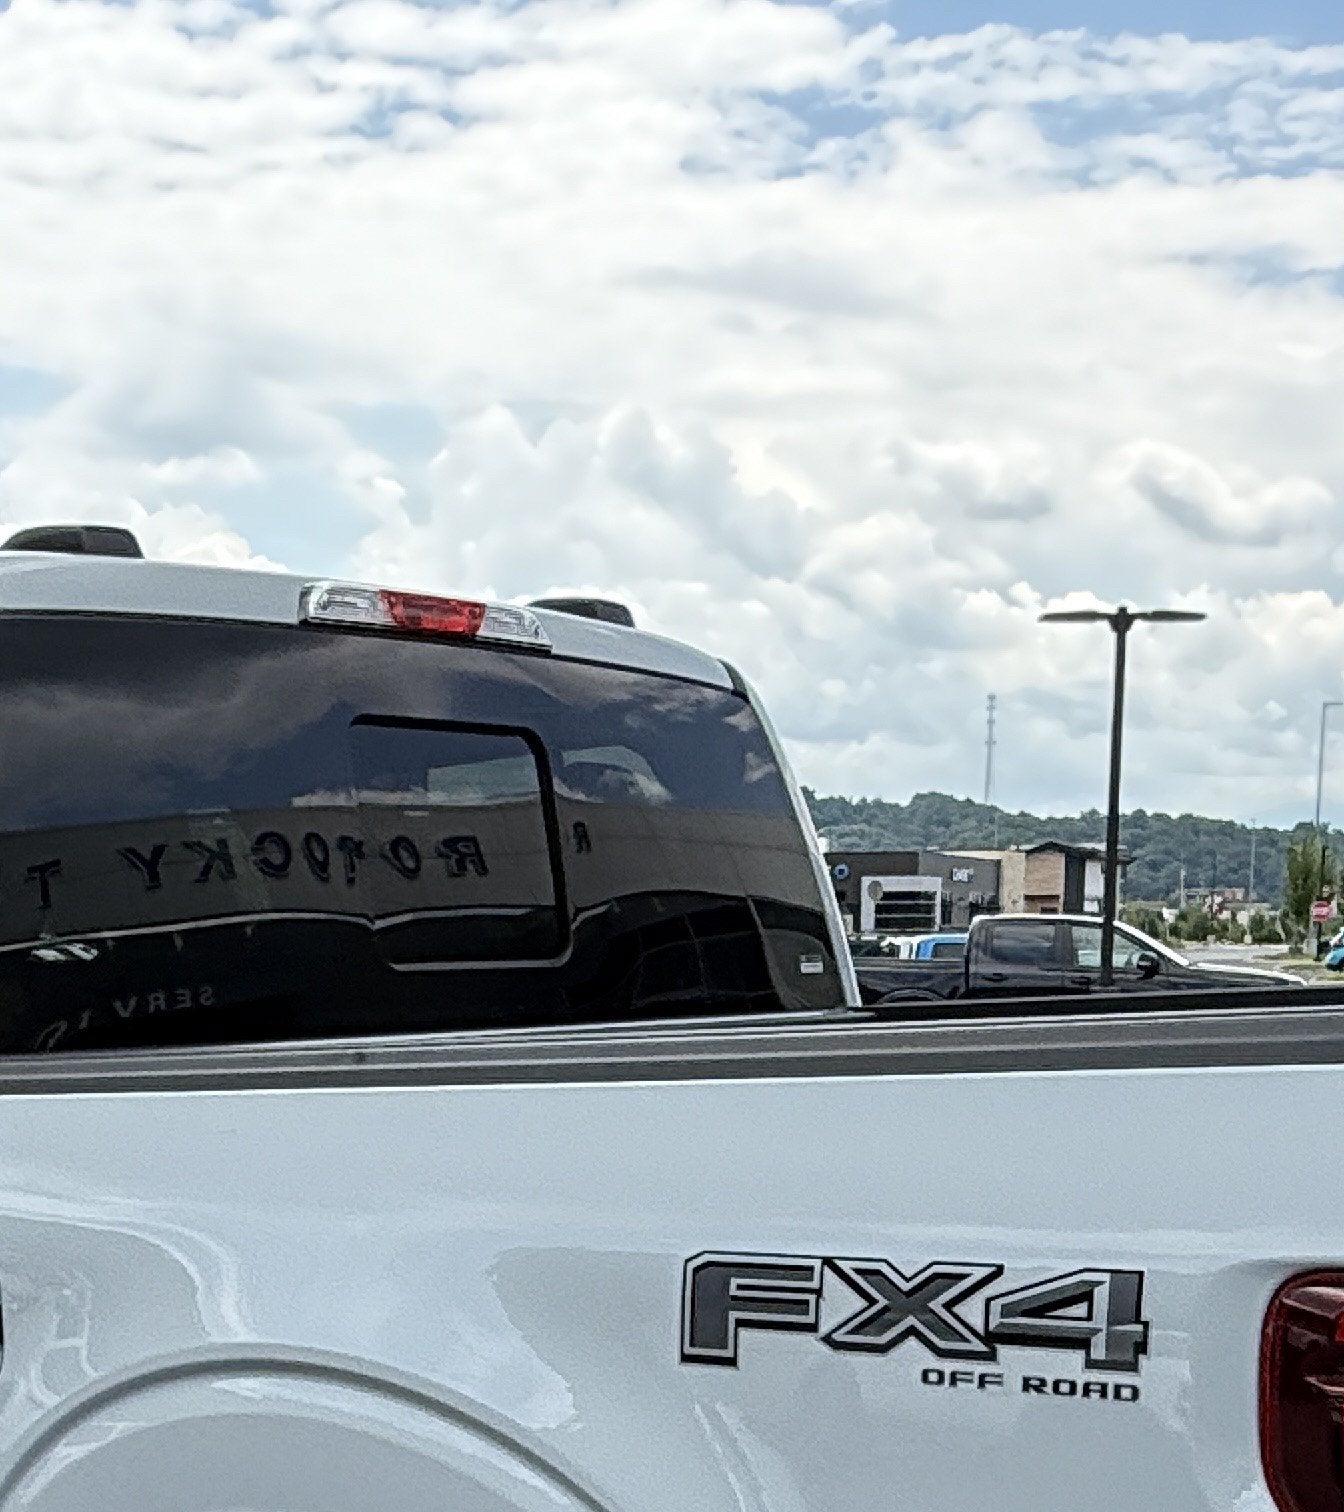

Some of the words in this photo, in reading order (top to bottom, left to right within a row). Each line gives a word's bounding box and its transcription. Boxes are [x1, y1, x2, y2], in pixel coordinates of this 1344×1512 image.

[680, 1251, 1150, 1372] FX4
[920, 1367, 1005, 1390] OFF
[1021, 1376, 1141, 1402] ROAD
